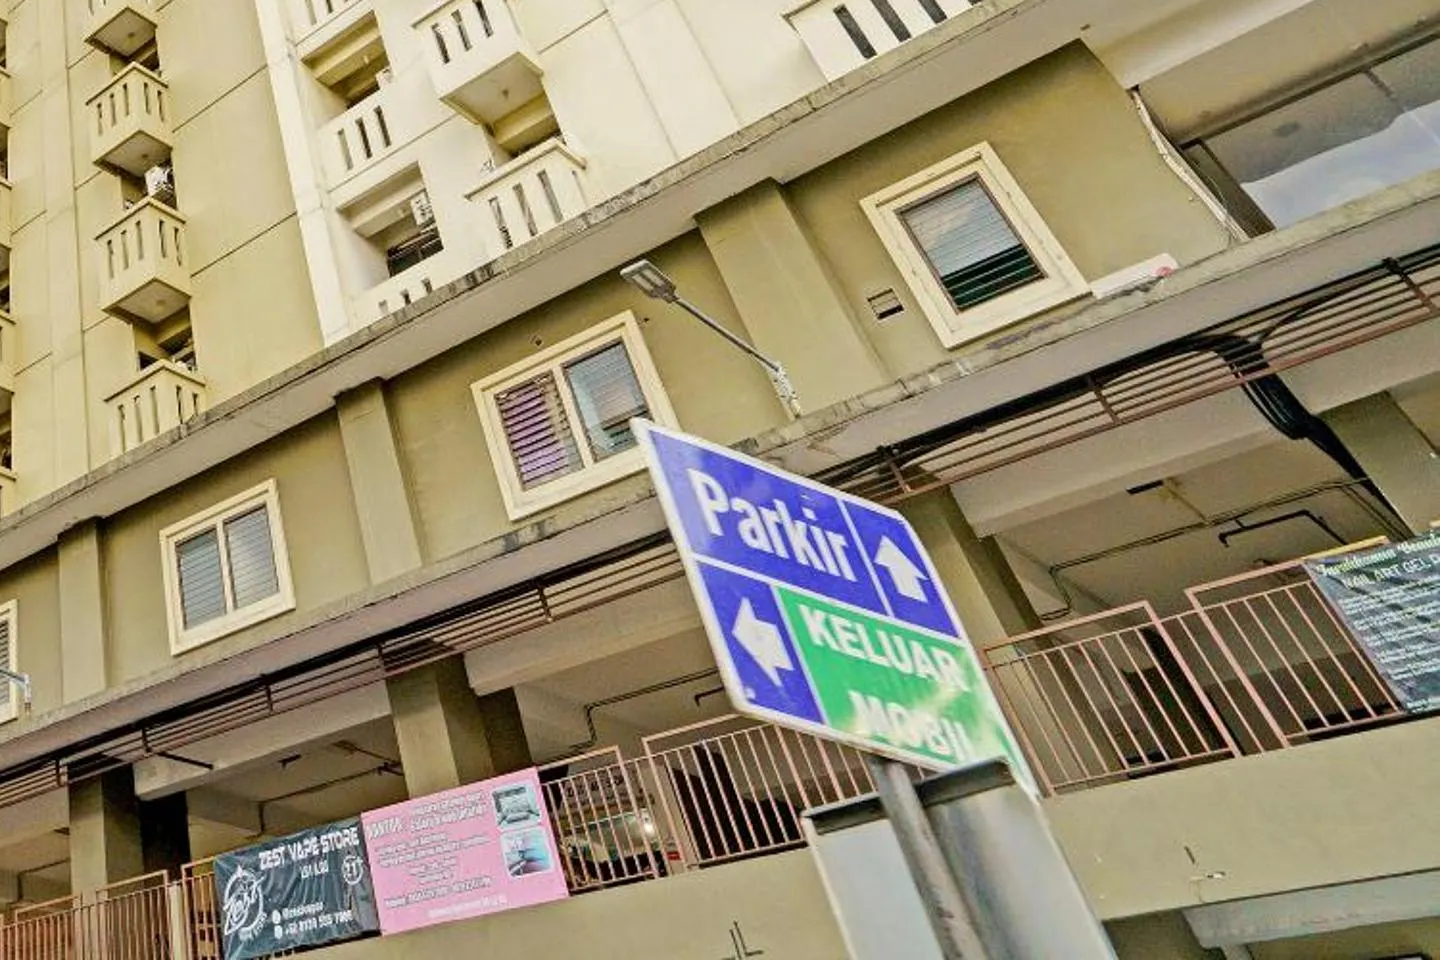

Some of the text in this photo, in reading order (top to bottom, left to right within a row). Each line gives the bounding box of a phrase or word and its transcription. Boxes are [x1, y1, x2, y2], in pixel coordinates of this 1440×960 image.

[686, 467, 858, 583] Parkir
[1374, 563, 1402, 581] ART
[798, 604, 970, 693] KELUAR
[287, 836, 320, 861] VAPE
[320, 826, 360, 854] STORE
